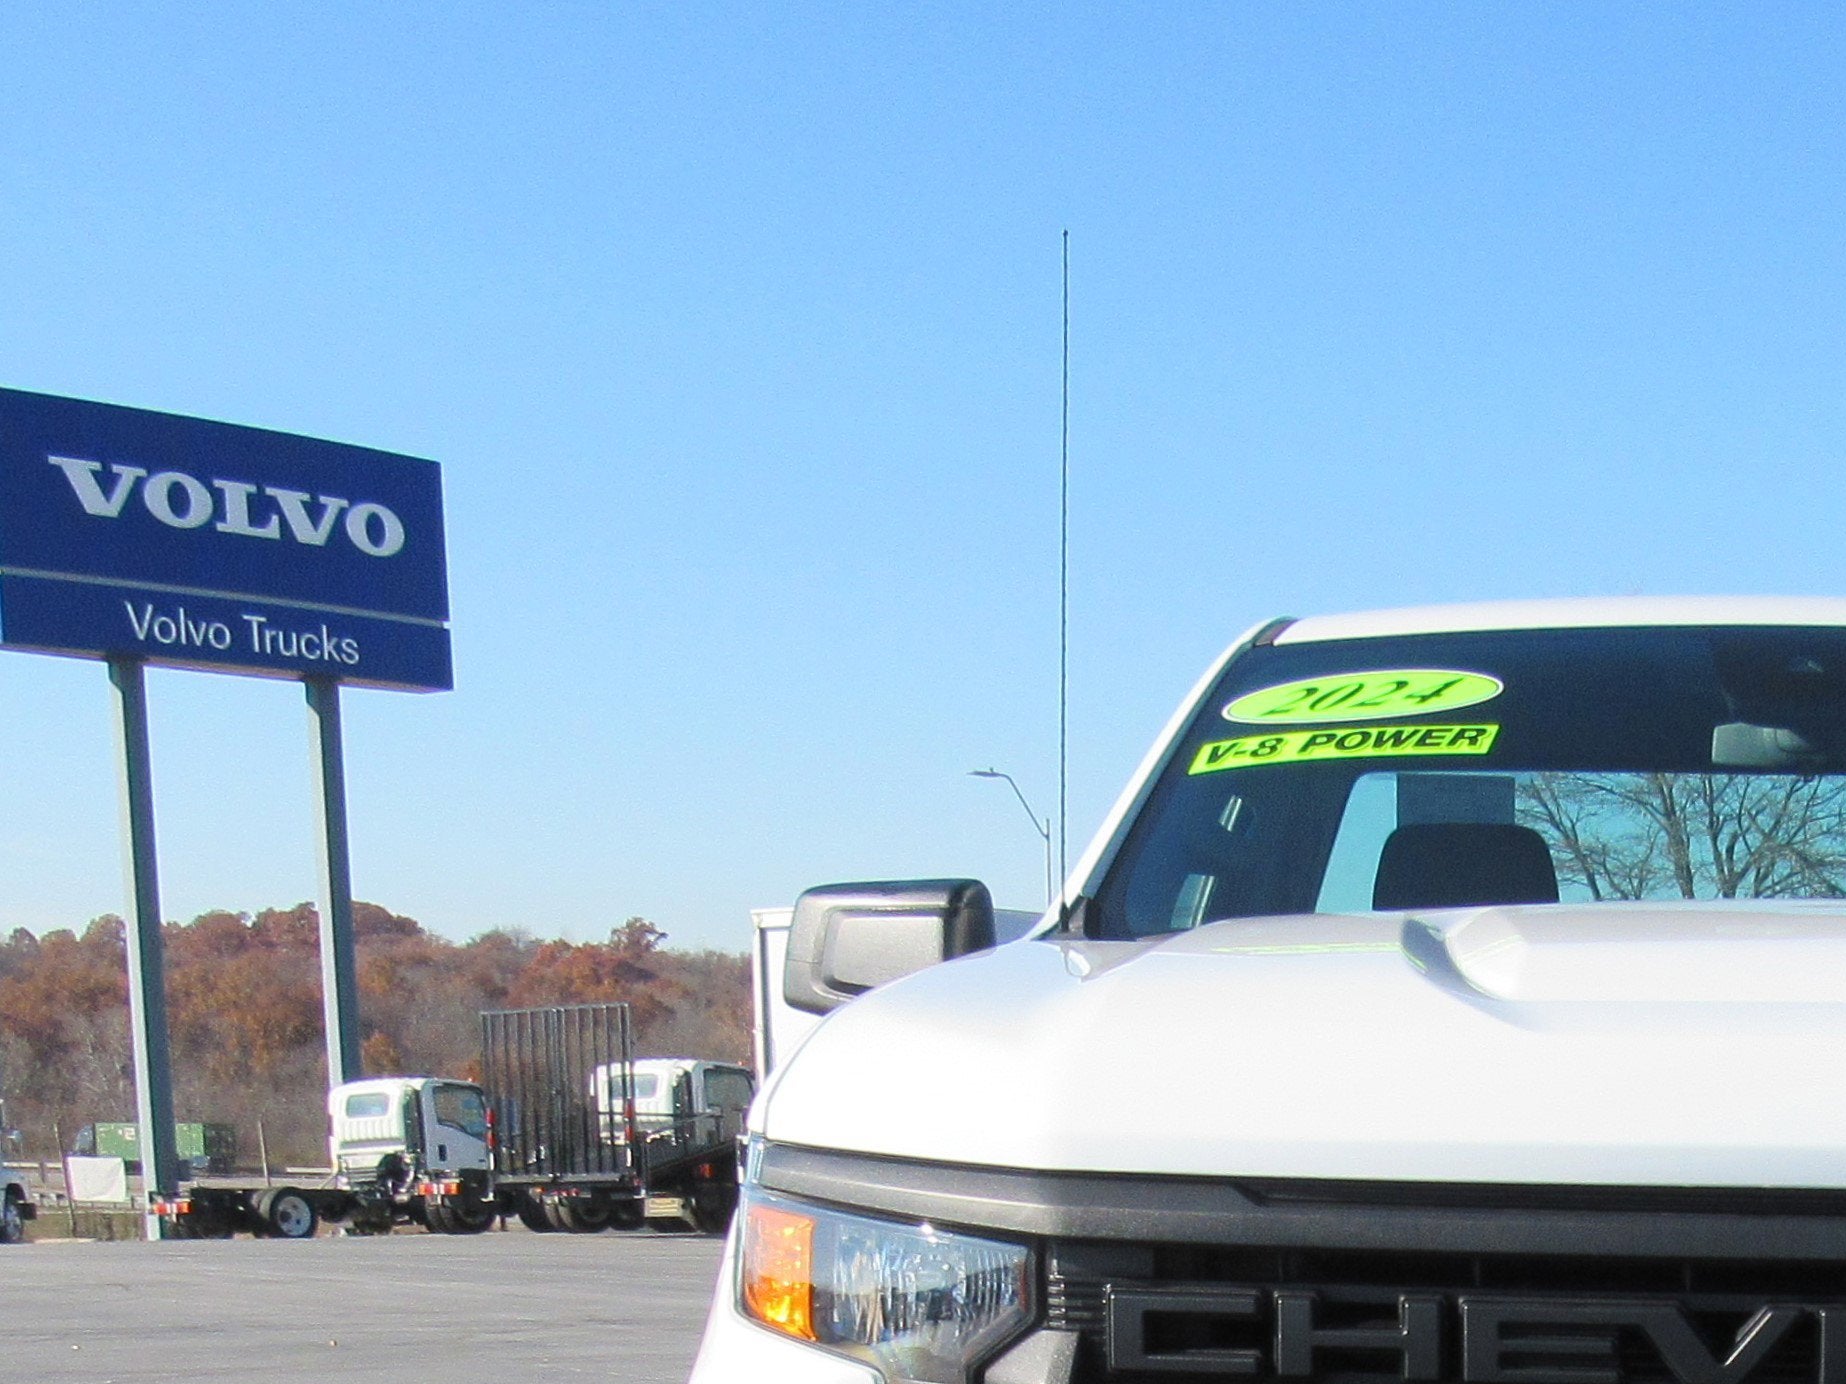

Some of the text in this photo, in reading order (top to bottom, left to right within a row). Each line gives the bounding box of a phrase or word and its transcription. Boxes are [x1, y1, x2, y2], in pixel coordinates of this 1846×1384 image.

[48, 455, 405, 557] VOLVO
[124, 601, 360, 665] Volvo Trucks
[1260, 677, 1465, 716] 2024
[1206, 727, 1488, 766] V-8 POWER
